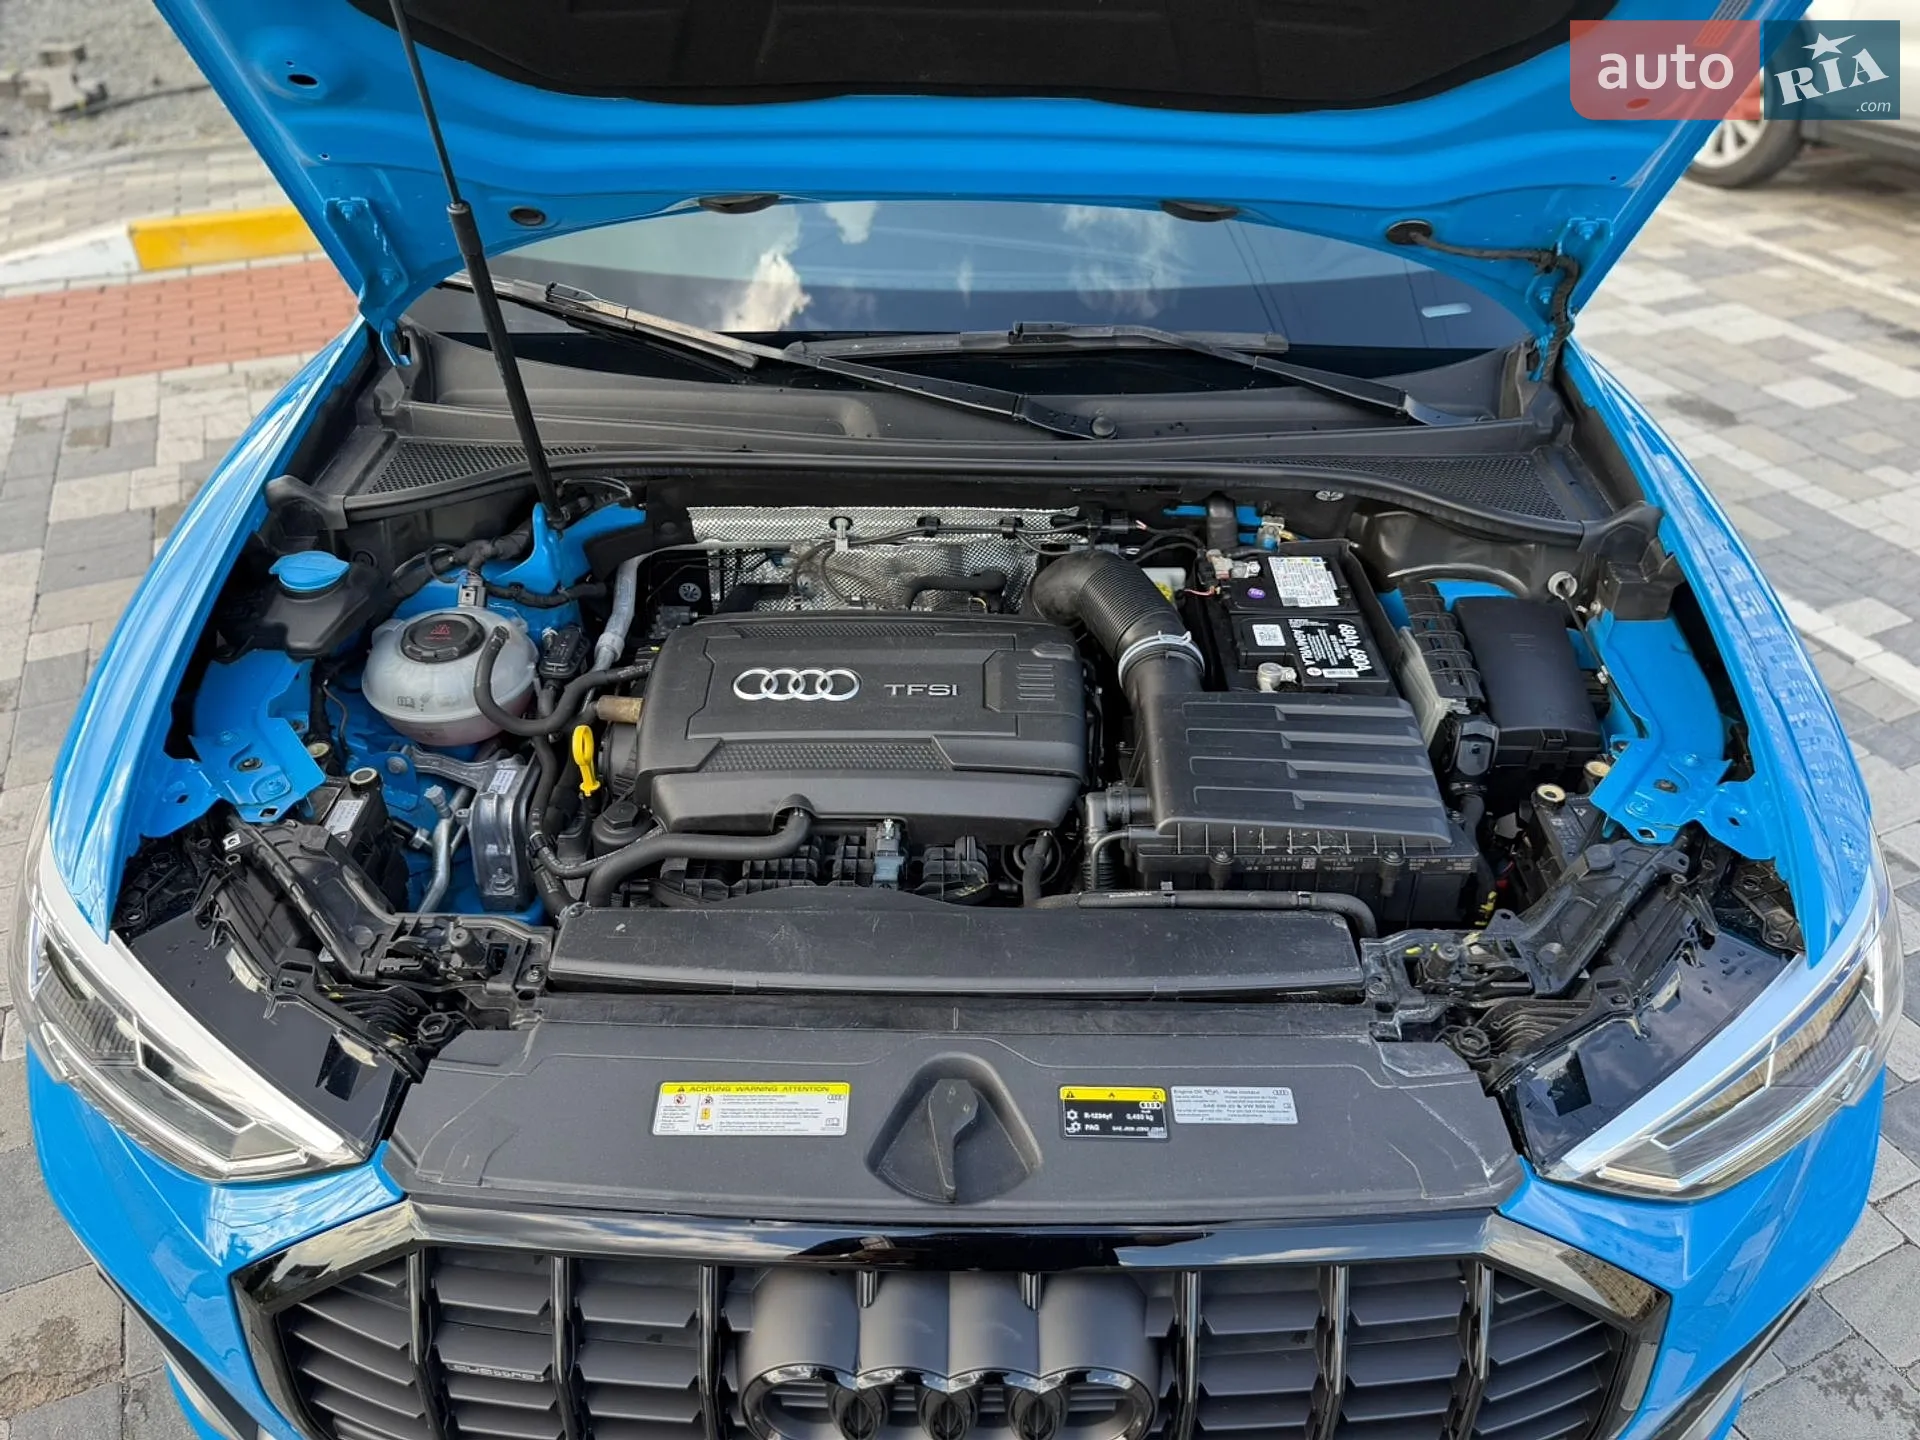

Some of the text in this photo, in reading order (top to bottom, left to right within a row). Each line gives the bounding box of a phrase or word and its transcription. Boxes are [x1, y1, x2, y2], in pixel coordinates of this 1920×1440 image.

[1338, 624, 1372, 671] 68Ah 680A
[884, 684, 957, 696] TFSI
